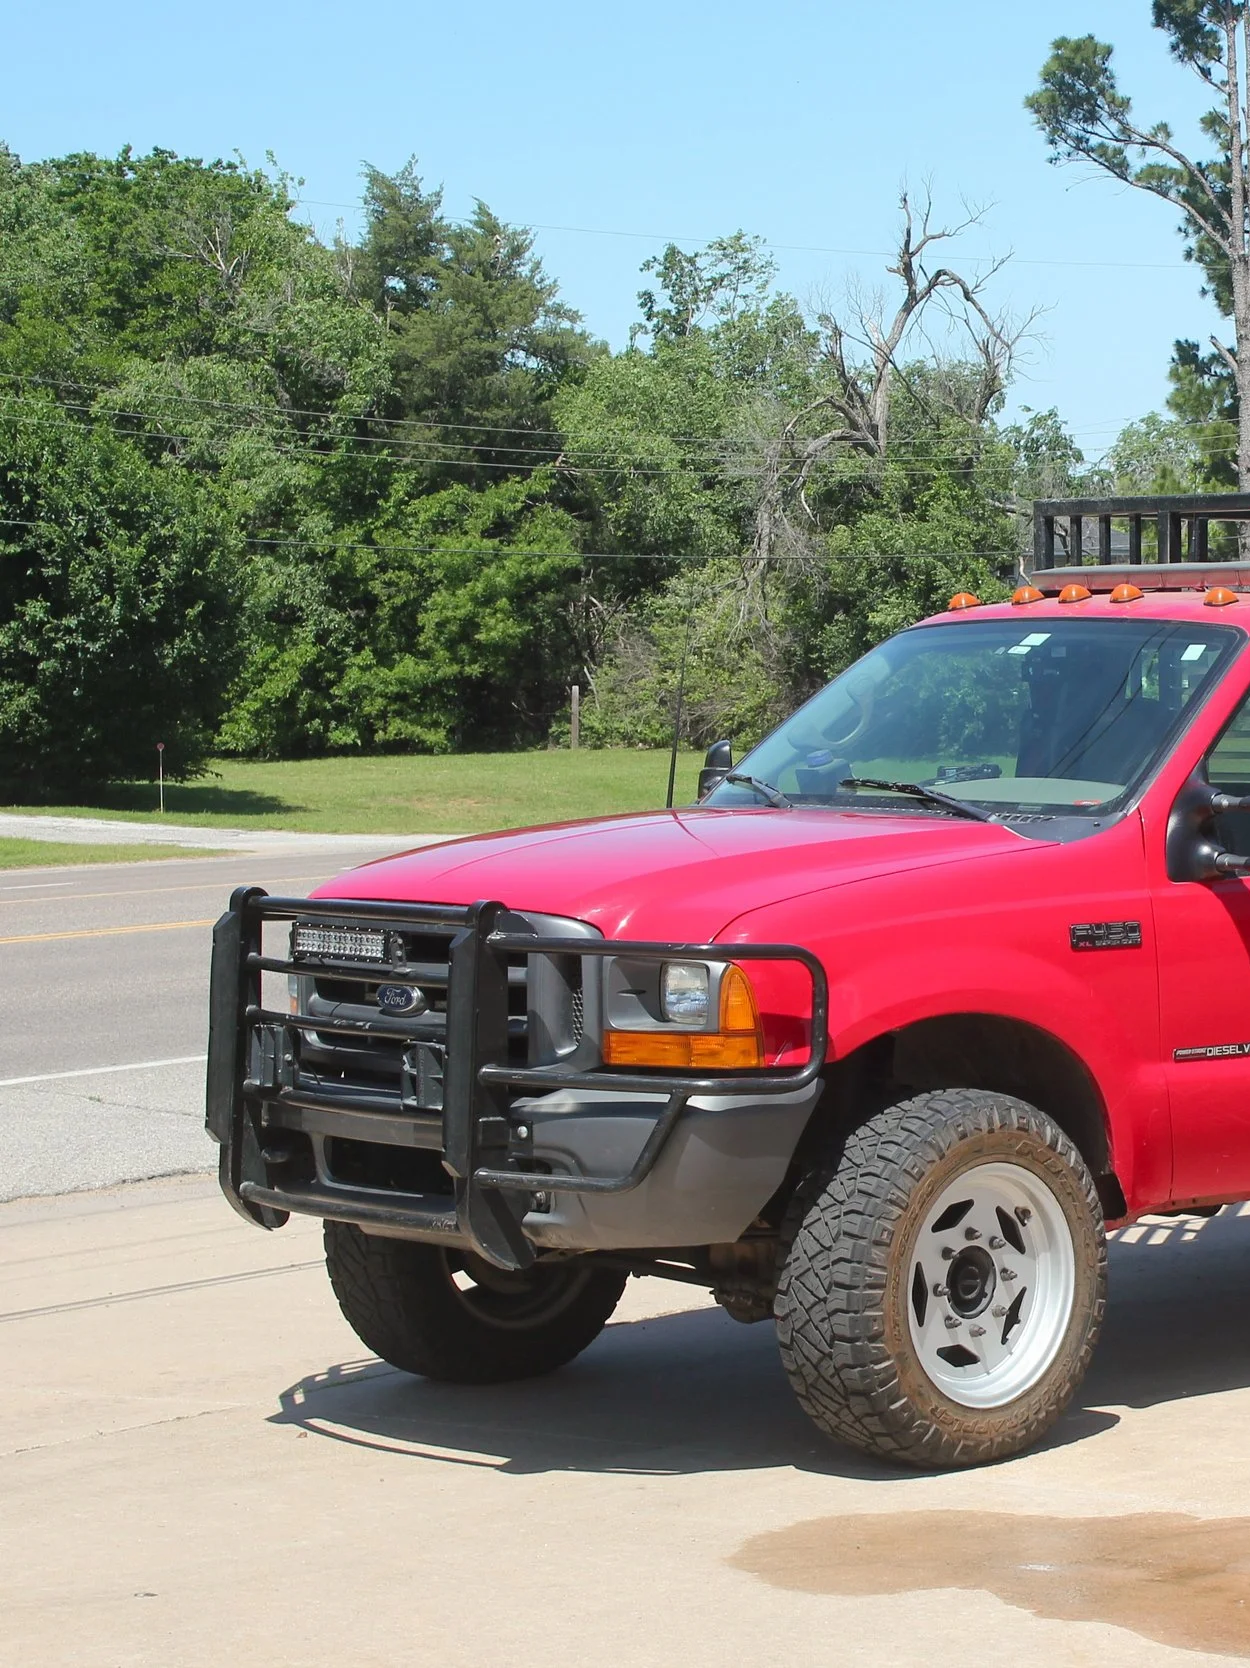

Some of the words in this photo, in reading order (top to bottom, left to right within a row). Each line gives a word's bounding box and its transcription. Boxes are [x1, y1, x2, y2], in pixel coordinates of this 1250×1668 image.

[1071, 921, 1141, 944] F-450
[384, 988, 407, 1007] Ford
[1206, 1044, 1242, 1057] DIESEL
